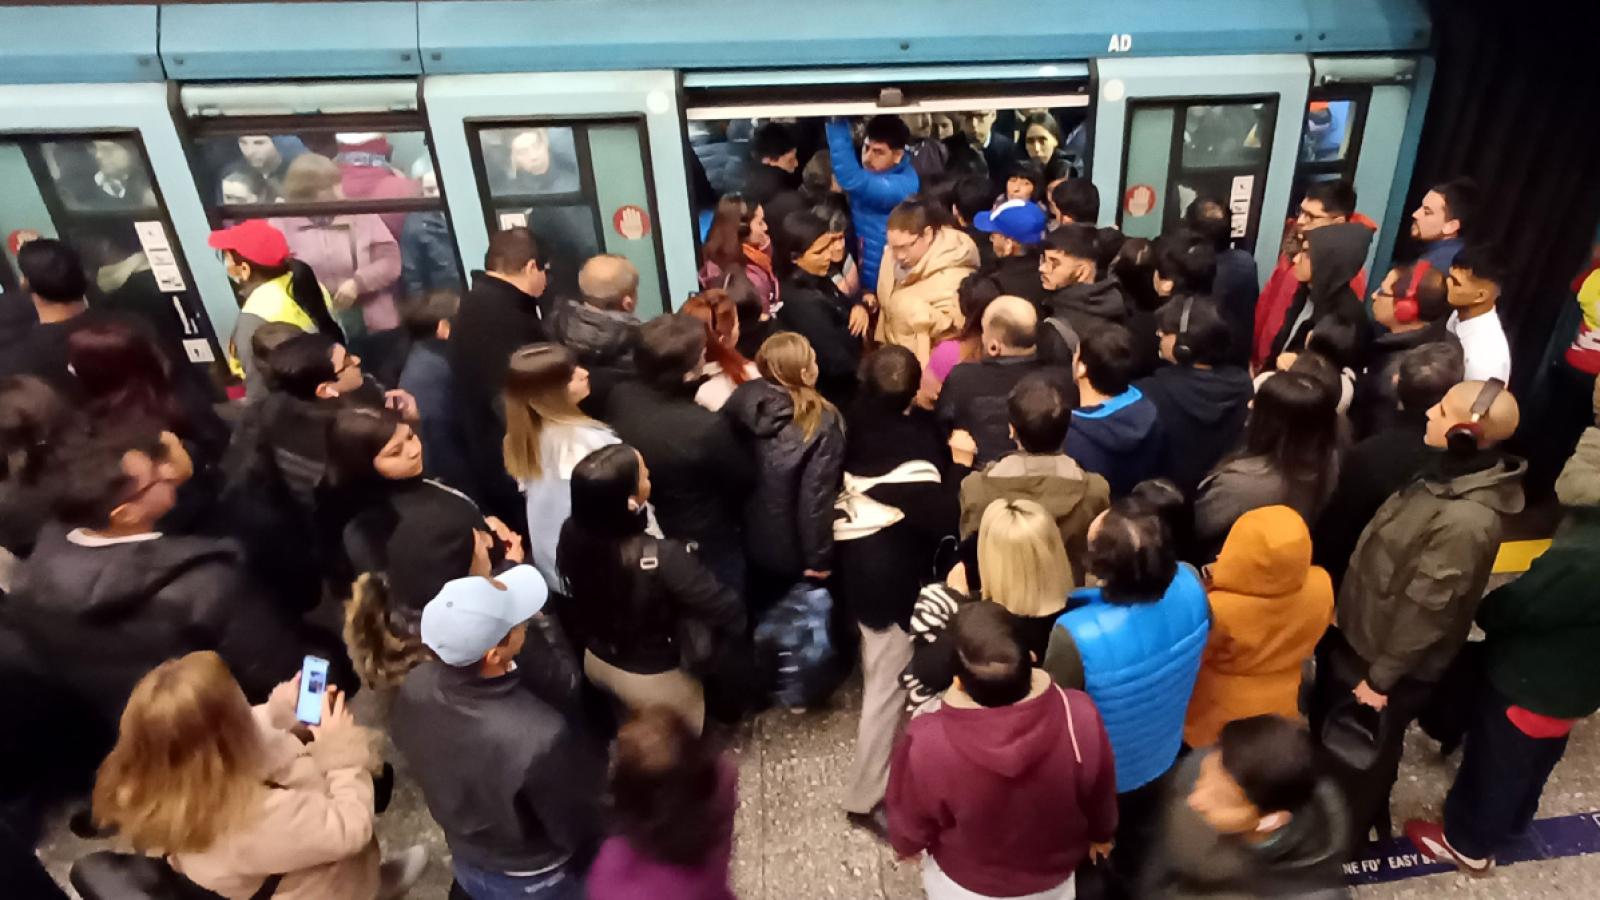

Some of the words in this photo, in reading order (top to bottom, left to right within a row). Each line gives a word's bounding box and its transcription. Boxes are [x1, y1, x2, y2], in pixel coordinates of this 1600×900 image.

[1107, 33, 1132, 53] AD
[1342, 862, 1360, 874] NE
[1387, 853, 1418, 869] EASY
